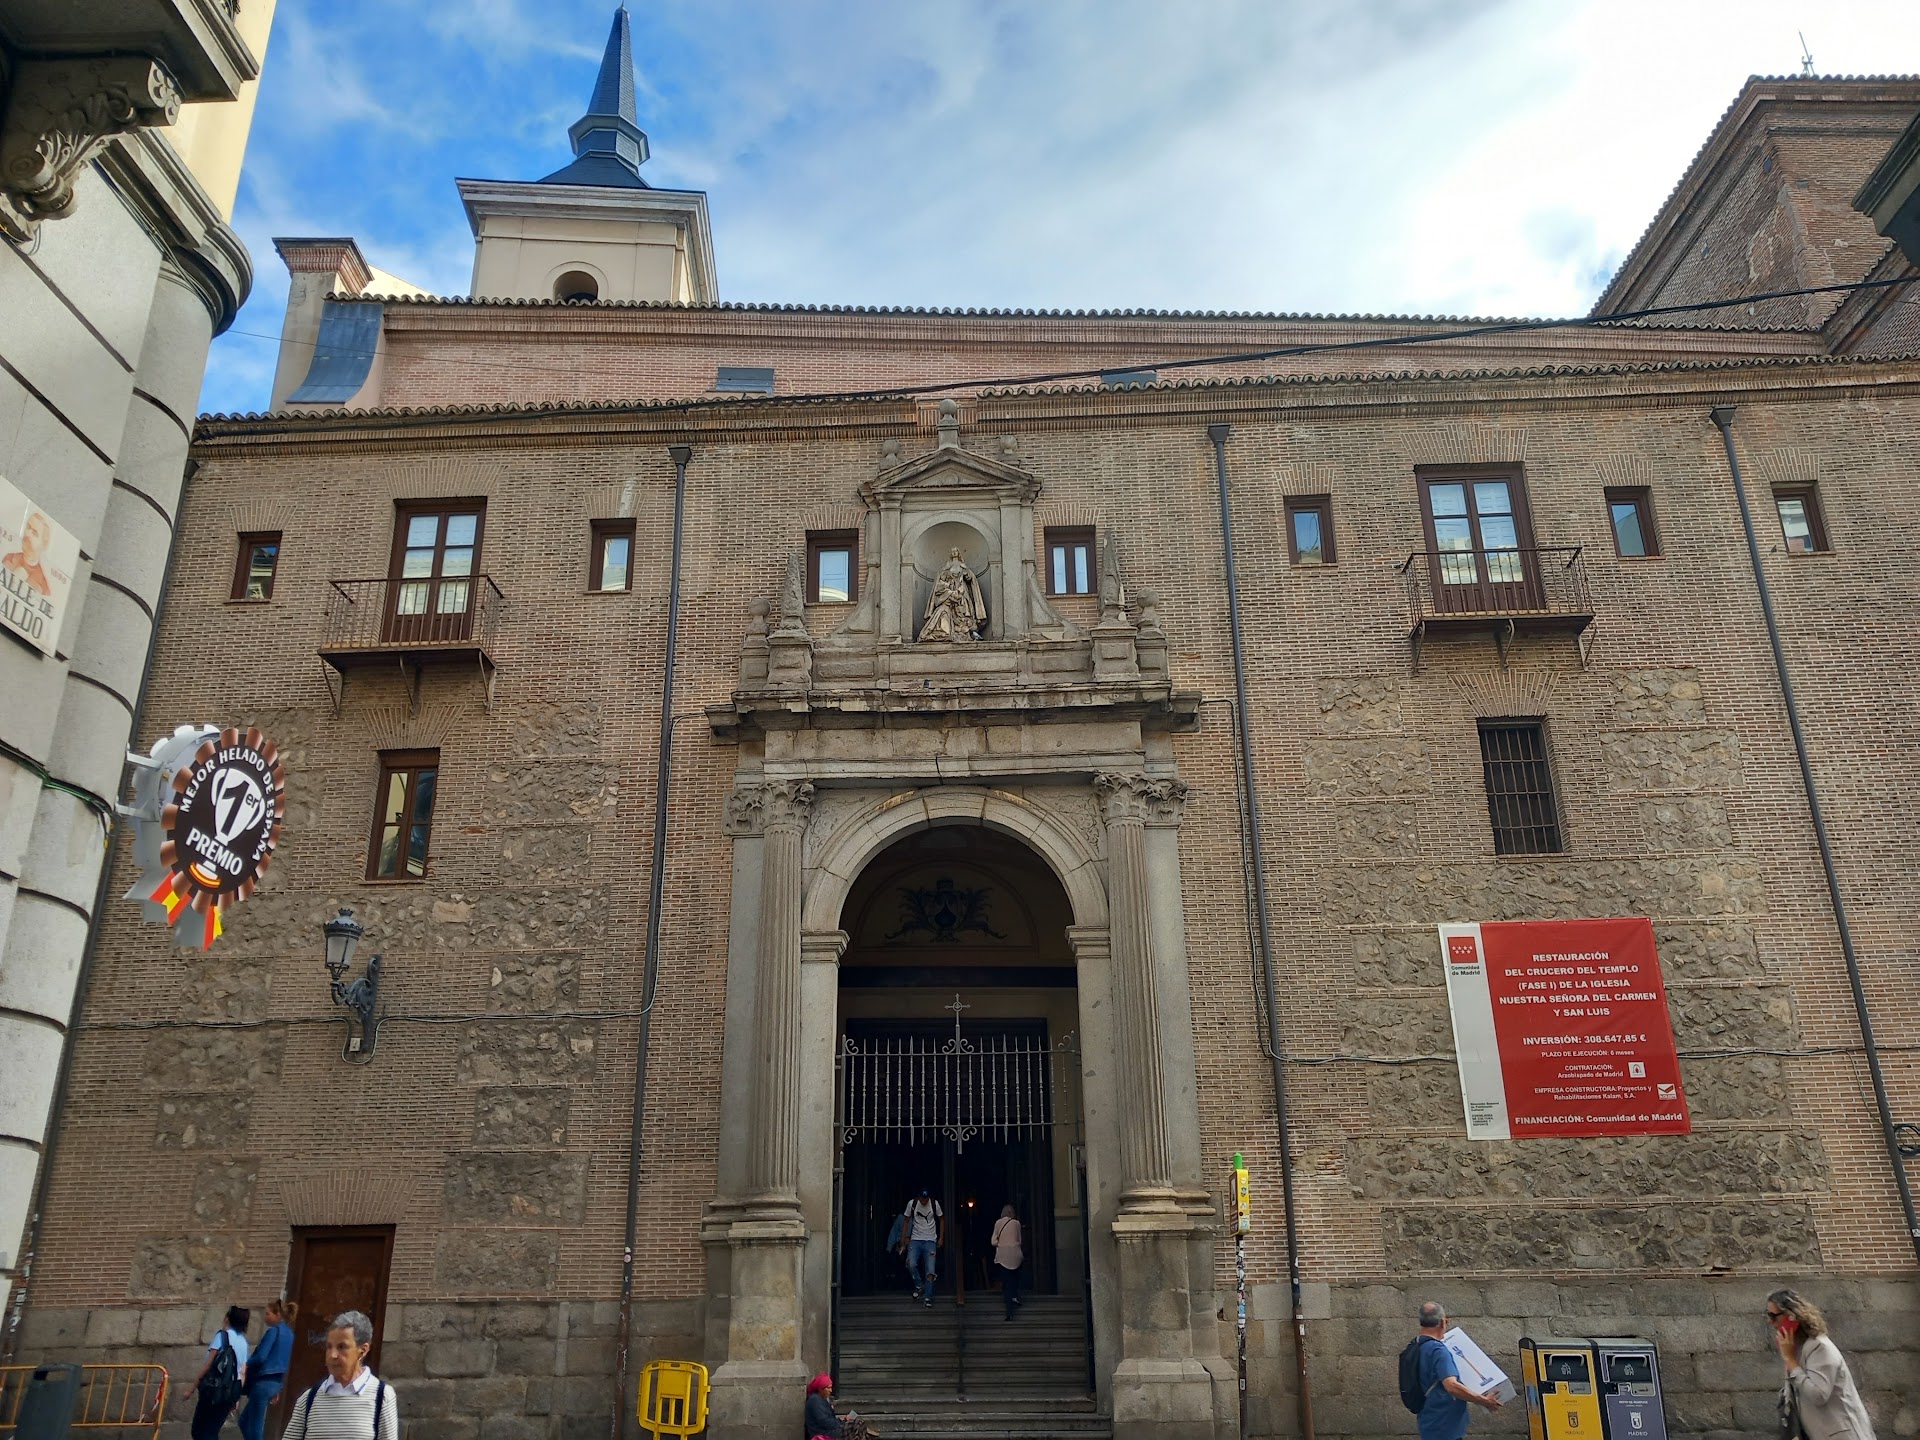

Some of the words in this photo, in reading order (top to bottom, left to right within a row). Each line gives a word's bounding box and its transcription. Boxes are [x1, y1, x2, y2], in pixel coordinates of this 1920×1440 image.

[38, 598, 54, 620] DE
[219, 747, 265, 771] HELADO
[180, 759, 216, 813] MEJOR
[262, 771, 275, 795] DE
[252, 798, 275, 861] ESPAÑA
[185, 827, 243, 876] PREMIO
[1532, 951, 1609, 962] RESTAURACIÓN
[1505, 968, 1524, 977] DEL
[1526, 966, 1575, 976] CRUCERO
[1577, 966, 1596, 975] DEL
[1598, 964, 1639, 974] TEMPLO
[1518, 981, 1547, 992] (FASE
[1549, 981, 1557, 991] I)
[1559, 980, 1573, 989] DE
[1575, 980, 1588, 989] LA
[1590, 979, 1631, 988] IGLESIA
[1499, 996, 1547, 1005] NUESTRA
[1549, 993, 1590, 1004] SEÑORA
[1592, 993, 1612, 1002] DEL
[1614, 992, 1657, 1001] CARMEN
[1553, 1009, 1561, 1017] Y
[1563, 1008, 1585, 1017] SAN
[1586, 1007, 1611, 1016] LUIS
[1523, 1035, 1582, 1046] INVERSIÓN:
[1583, 1034, 1638, 1044] 308.647,85
[1639, 1034, 1647, 1042] €
[1572, 1049, 1609, 1057] EJECUCIÓN:
[1564, 1063, 1614, 1071] CONTRATACIÓN:
[1557, 1071, 1594, 1079] Arzobispado
[1515, 1115, 1584, 1125] FINANCIACIÓN:
[1586, 1114, 1636, 1123] Comunidad
[1638, 1114, 1650, 1122] de
[1651, 1113, 1683, 1122] Madrid
